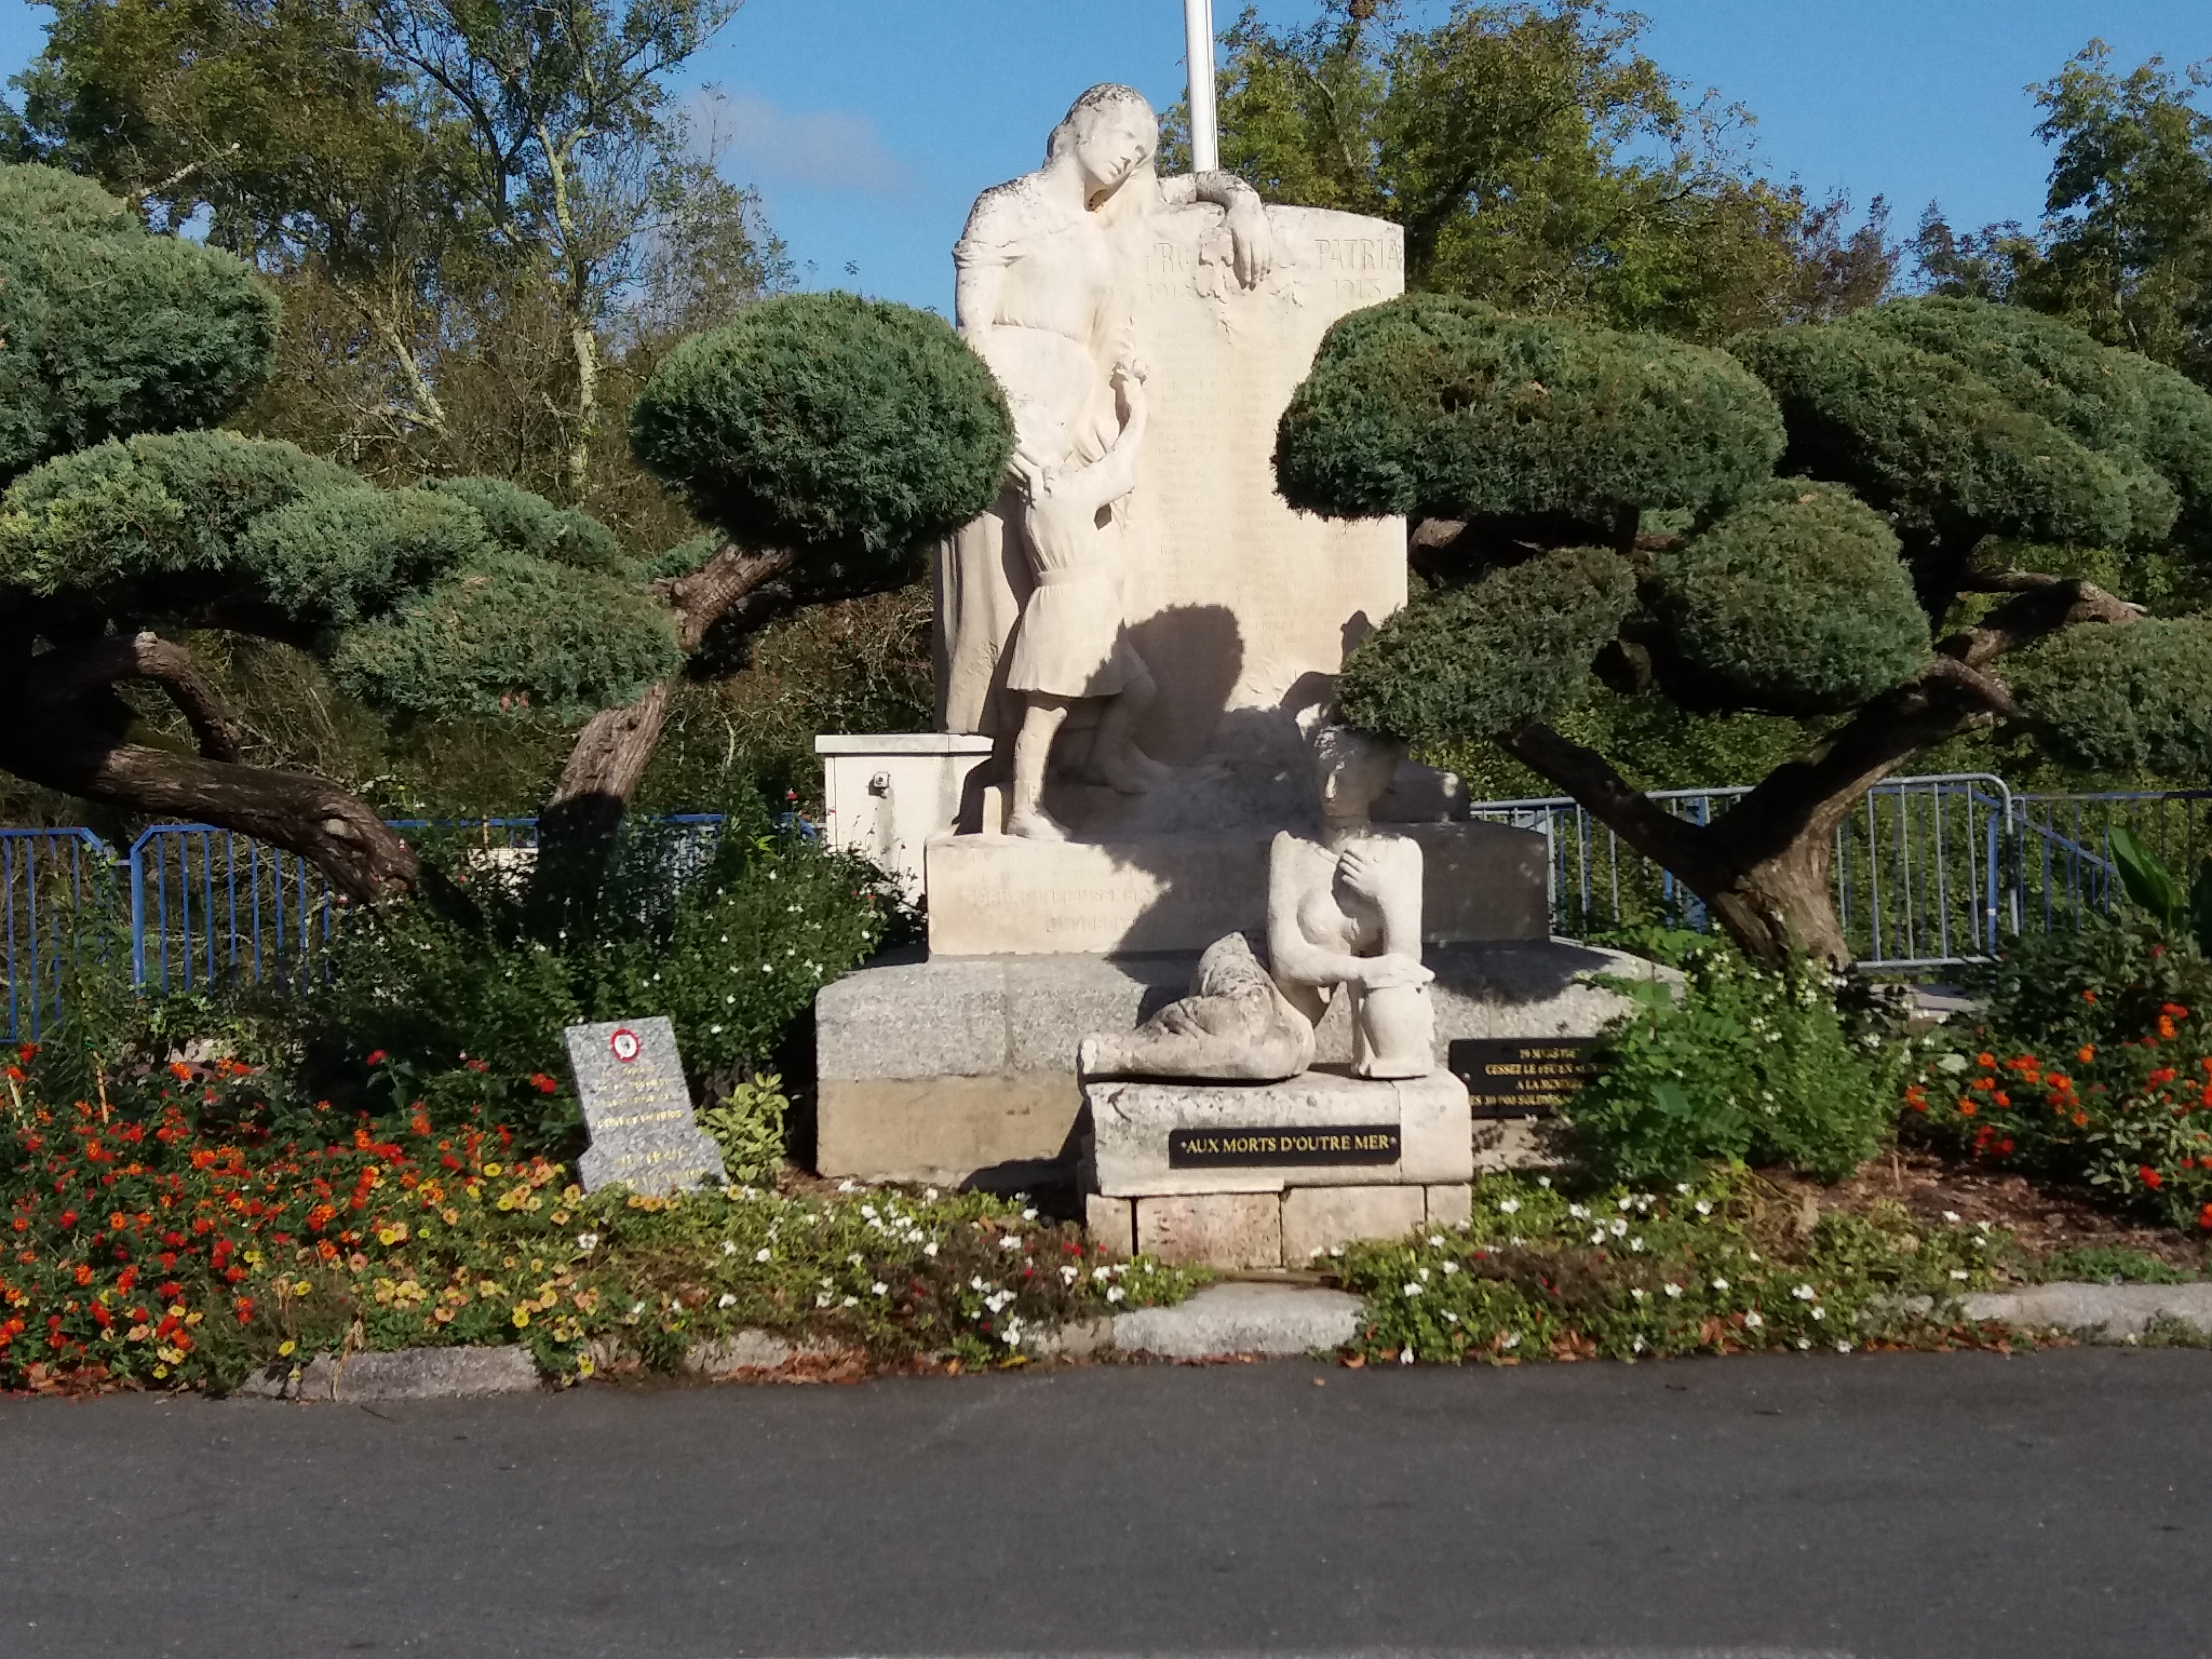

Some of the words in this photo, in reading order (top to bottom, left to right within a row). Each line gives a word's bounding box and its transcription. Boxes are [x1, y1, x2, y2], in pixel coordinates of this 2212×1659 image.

[1314, 238, 1403, 271] PATRIA
[1523, 1064, 1536, 1075] LE
[1186, 1137, 1219, 1155] AUX
[1223, 1137, 1276, 1153] MORTS
[1280, 1135, 1351, 1152] D'OUTRE
[1355, 1134, 1390, 1150] MER
